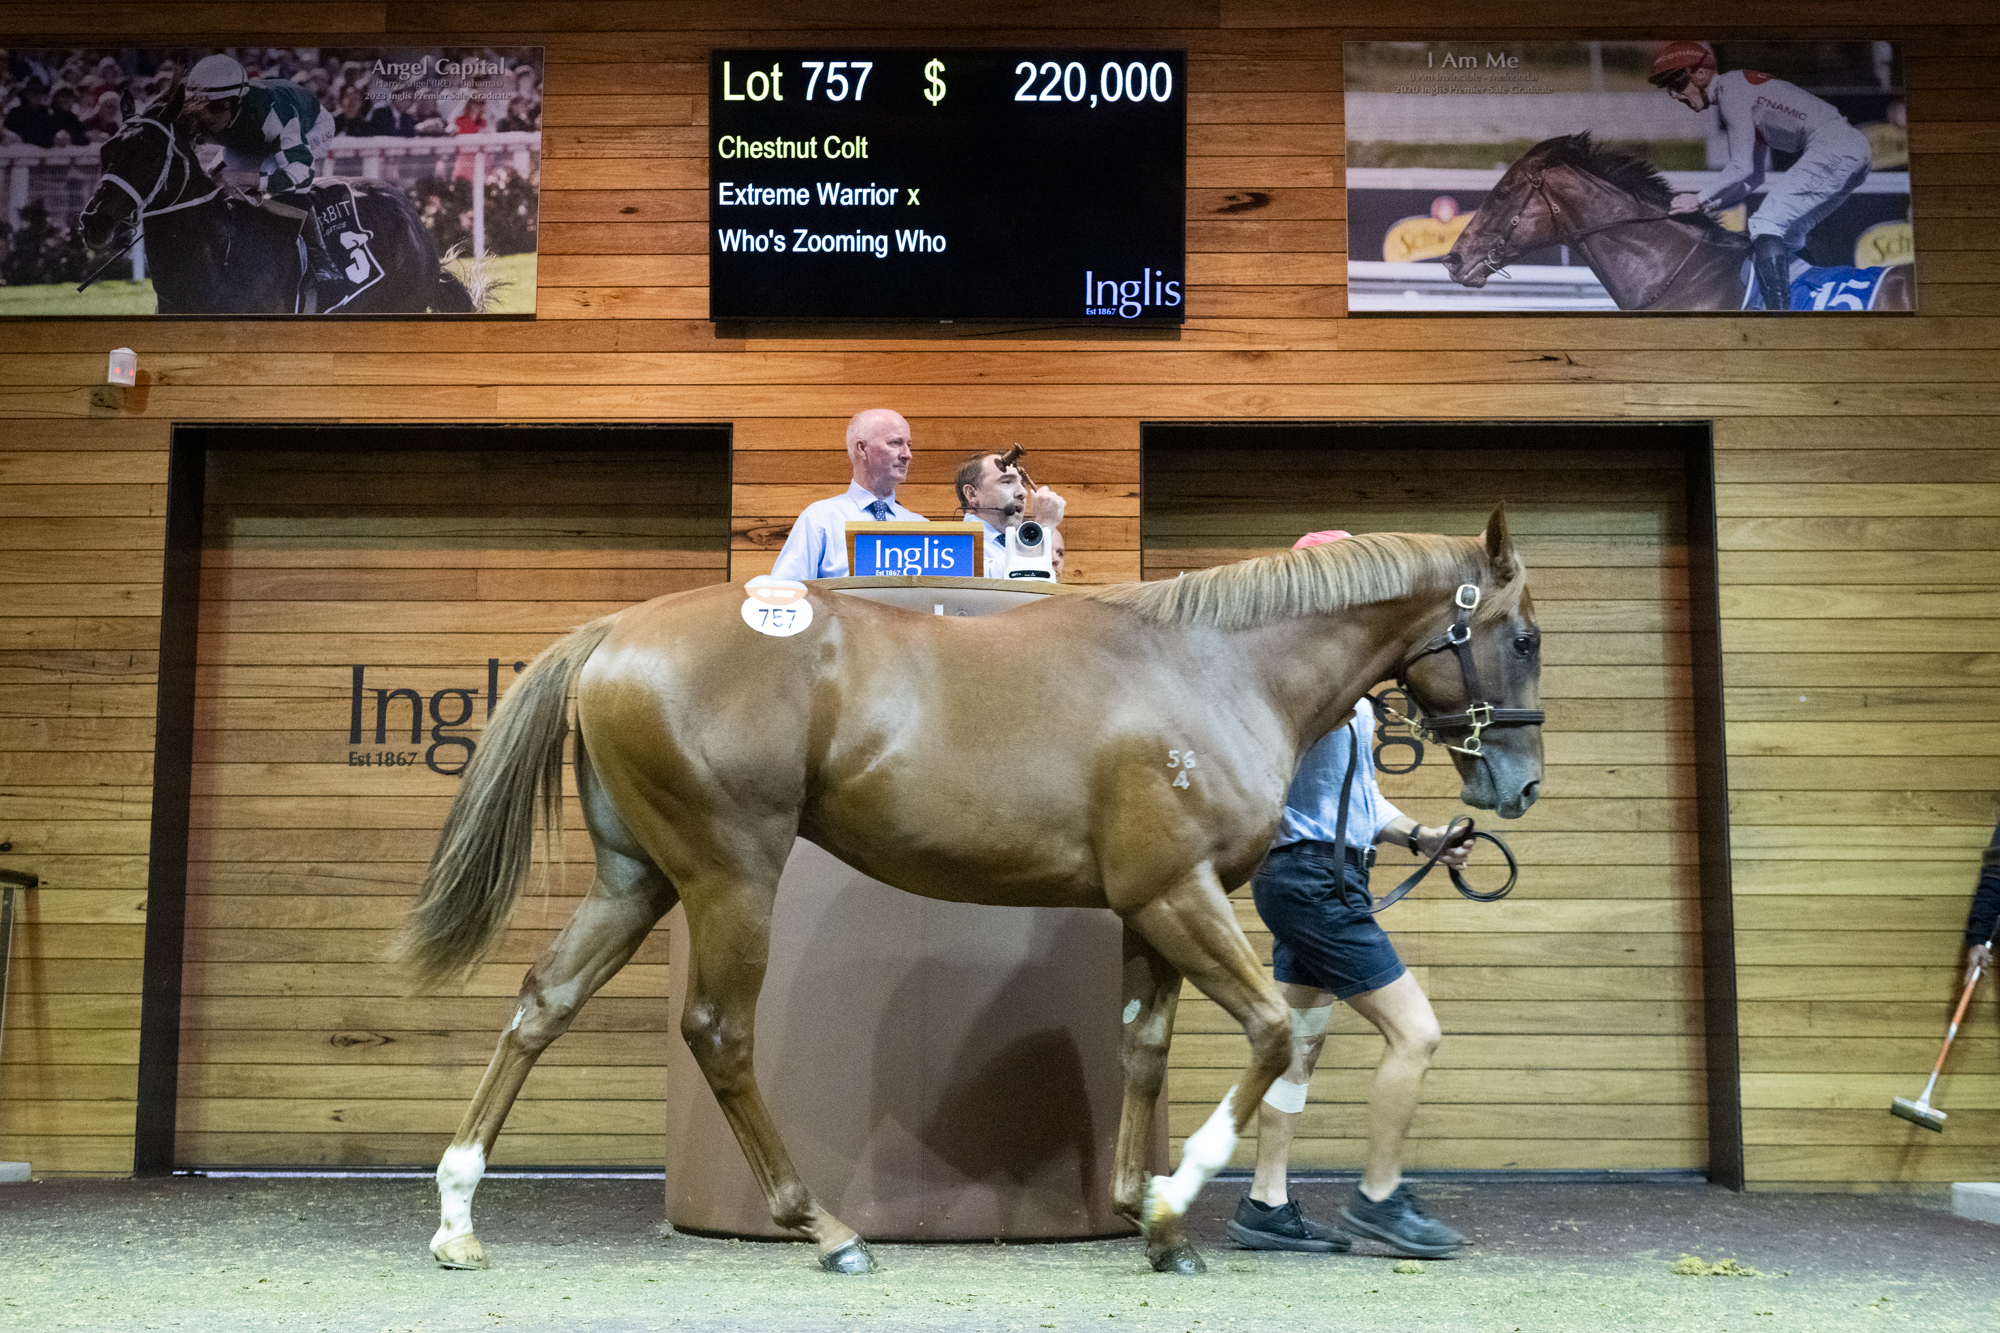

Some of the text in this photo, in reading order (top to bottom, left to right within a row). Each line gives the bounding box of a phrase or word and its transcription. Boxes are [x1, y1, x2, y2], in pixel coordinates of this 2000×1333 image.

[371, 56, 505, 80] Angel Capital
[1428, 52, 1519, 69] I Am Me
[404, 80, 429, 90] Angel
[723, 58, 1173, 109] Lot 757 $ 220,000
[1395, 85, 1554, 96] 2020 Inglis Premier Sale Graduate
[364, 91, 512, 102] 2023 Inglis Premier Sale Graduate
[718, 135, 869, 159] Chestnut Colt
[718, 182, 921, 206] Extreme Warrior x
[318, 200, 350, 231] RBIT
[718, 229, 947, 259] Who's Zooming Who
[339, 230, 371, 284] 3
[1085, 267, 1182, 319] Inglis
[1810, 279, 1871, 311] 15
[1085, 308, 1117, 316] Est 1867
[875, 537, 955, 576] Inglis
[758, 608, 797, 629] 757
[350, 658, 525, 775] Ingl
[349, 751, 418, 767] Est 1867
[1166, 750, 1196, 769] 56
[1172, 770, 1191, 790] 4
